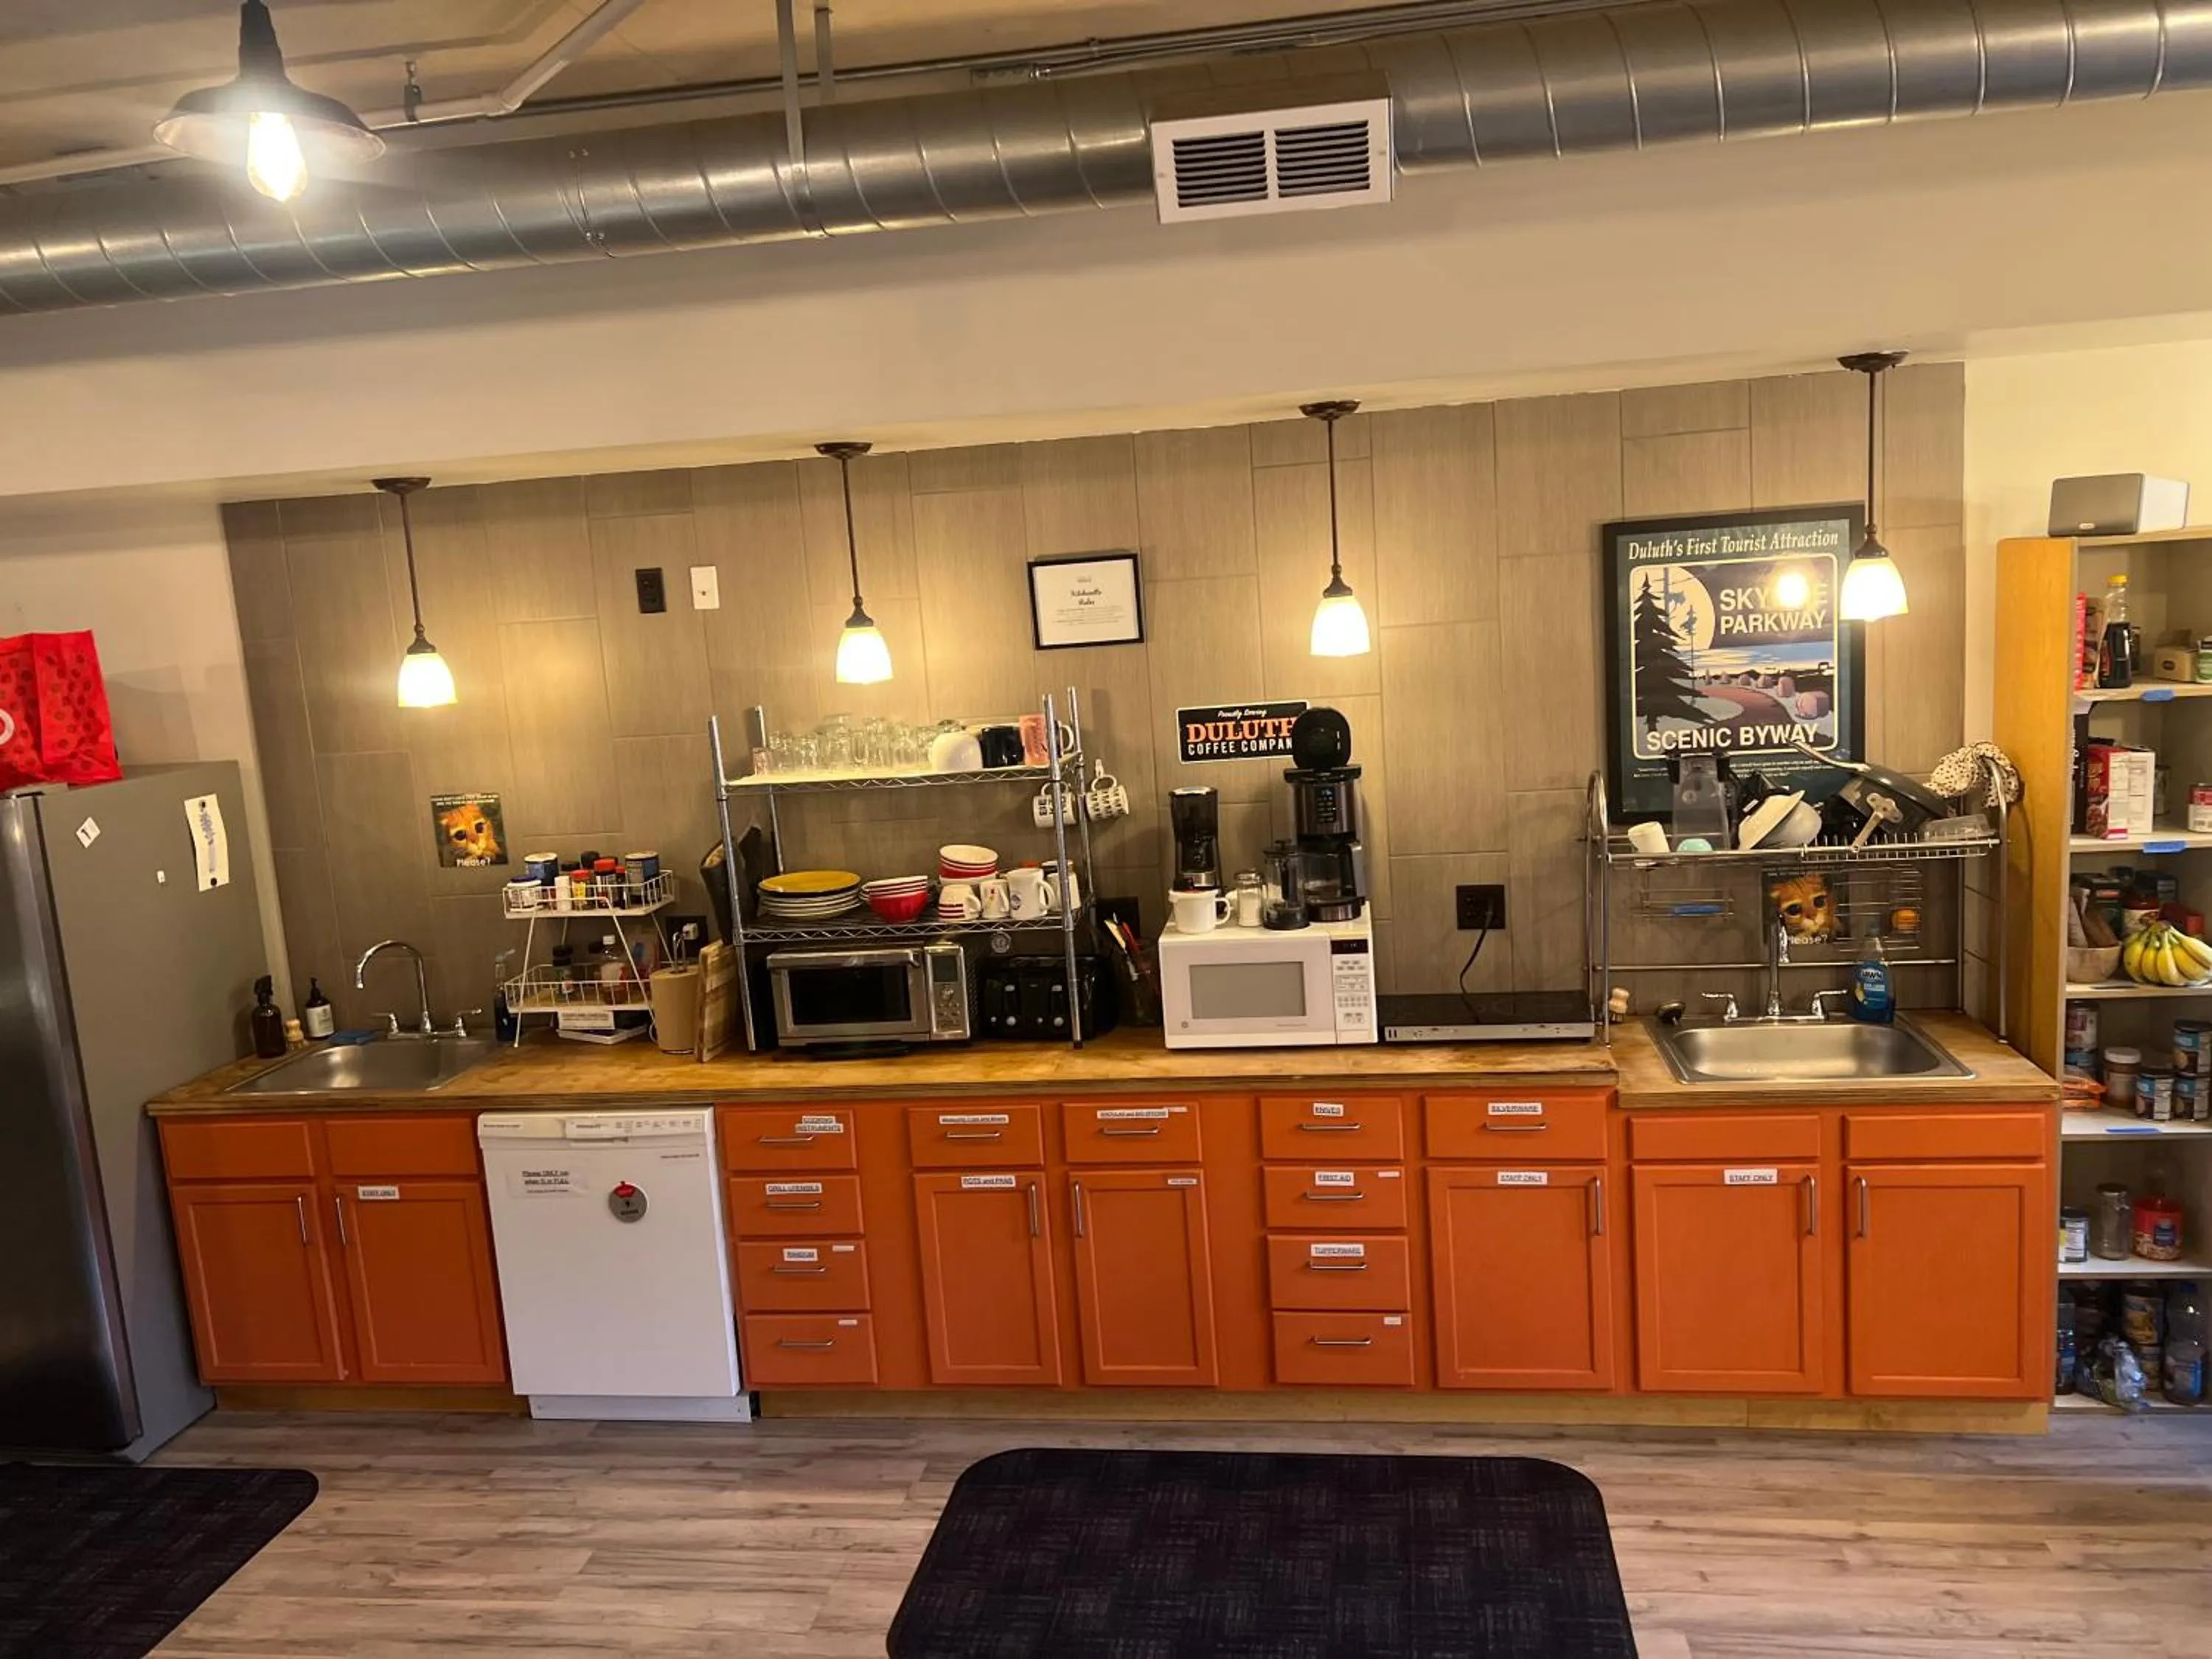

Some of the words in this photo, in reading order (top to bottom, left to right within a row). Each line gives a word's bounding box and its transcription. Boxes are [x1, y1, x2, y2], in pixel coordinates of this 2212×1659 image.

[1629, 539, 1683, 560] Duluth's
[1686, 538, 1717, 556] First
[1721, 534, 1767, 554] Tourist
[1770, 529, 1838, 550] Attraction
[1719, 584, 1828, 611] SKYE
[1720, 610, 1826, 635] PARKWAY
[1188, 742, 1236, 755] COFFEE
[1646, 728, 1731, 750] SCENIC
[1739, 723, 1819, 745] BYWAY
[1729, 1175, 1751, 1183] STAFF
